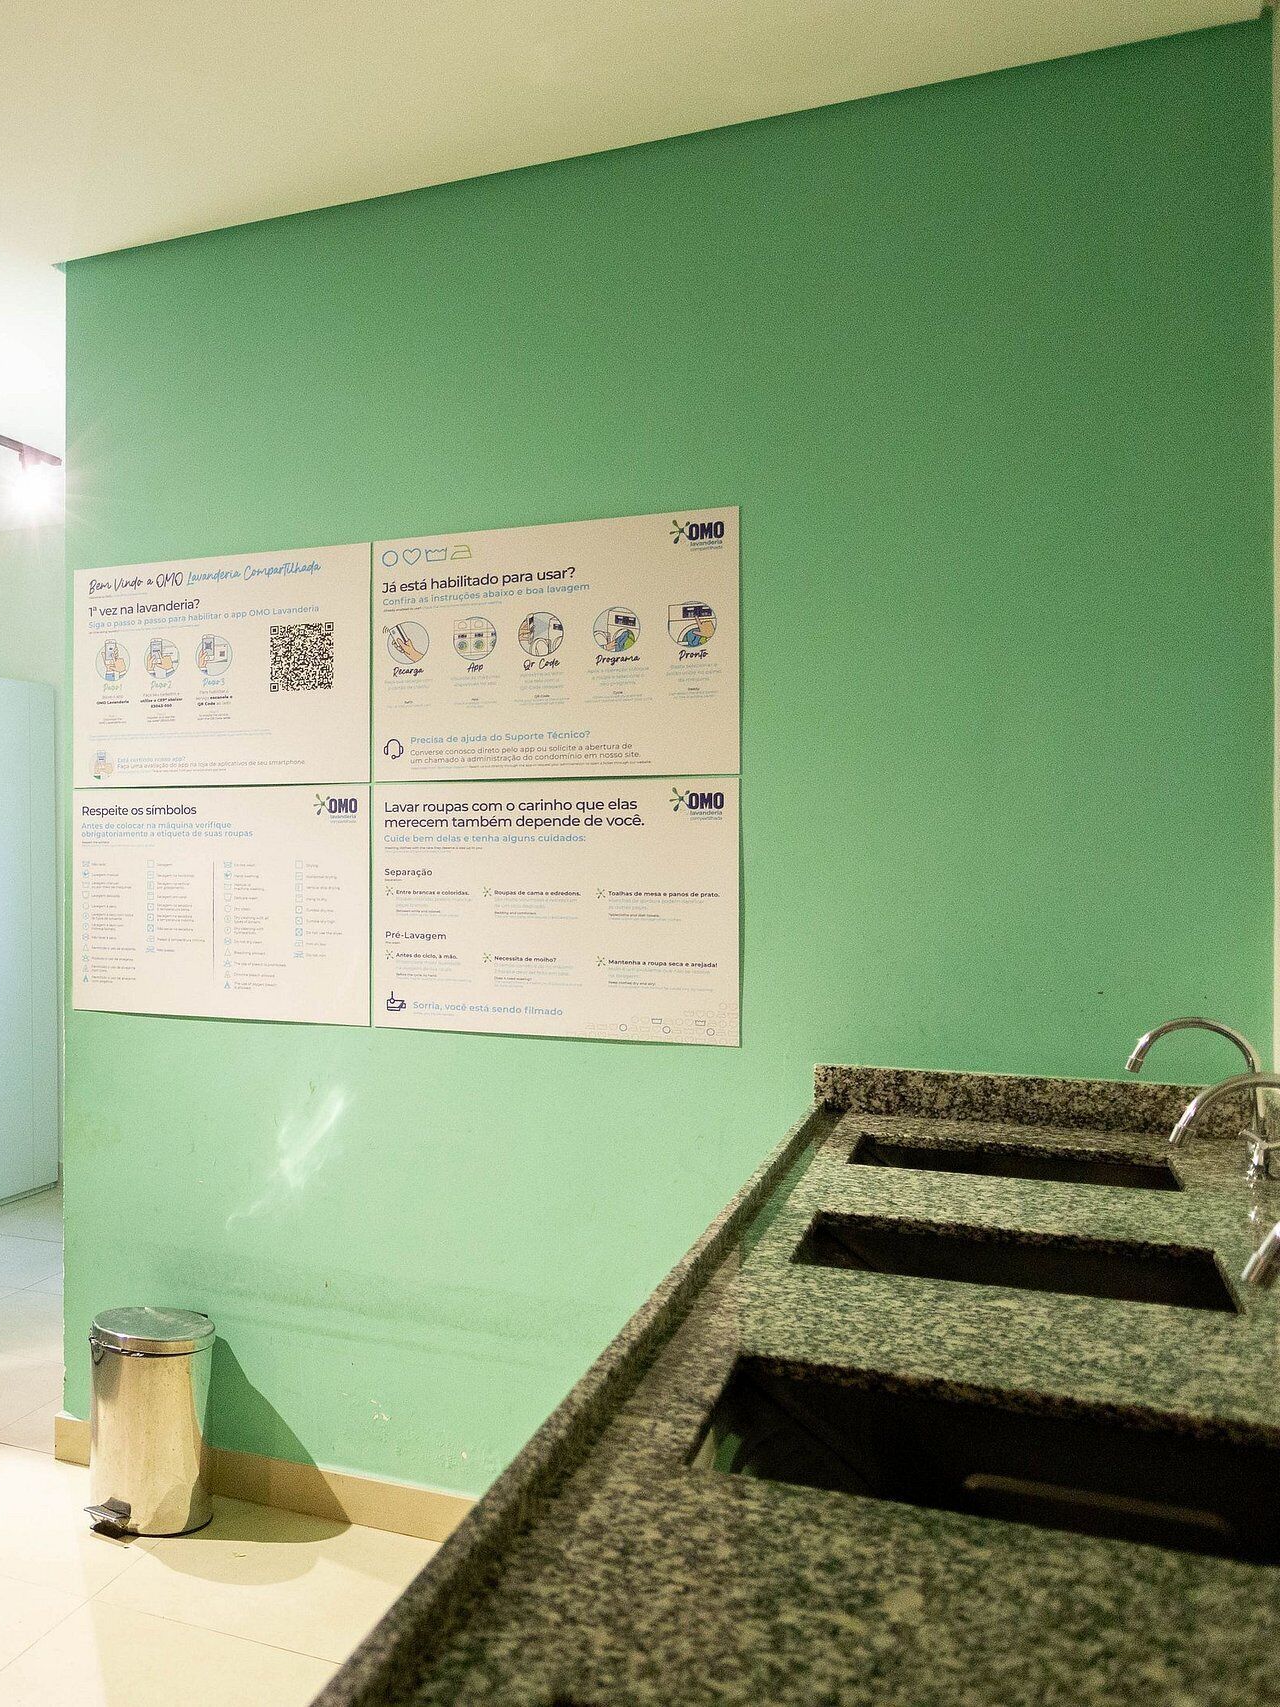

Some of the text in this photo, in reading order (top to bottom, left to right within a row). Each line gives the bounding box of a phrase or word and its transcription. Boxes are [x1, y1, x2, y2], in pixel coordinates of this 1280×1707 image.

[689, 520, 725, 540] OMO
[89, 579, 111, 595] Bem
[114, 577, 143, 591] Vindo
[156, 572, 183, 588] OMO
[187, 569, 241, 586] Lavanderia
[244, 560, 321, 580] Compartilhada
[382, 566, 576, 594] Já está habilitado para usar?
[383, 597, 416, 606] Confira
[431, 591, 480, 602] instruções
[483, 589, 514, 599] abaixo
[526, 585, 544, 595] boa
[547, 583, 590, 594] lavagem
[100, 608, 117, 616] vez
[120, 606, 134, 615] na
[137, 598, 200, 613] lavanderia?
[89, 621, 105, 630] Siga
[113, 619, 135, 628] passo
[144, 617, 166, 626] passo
[168, 616, 186, 625] para
[188, 612, 221, 621] habilitar
[231, 611, 247, 620] app
[249, 608, 271, 617] OMO
[273, 605, 320, 616] Lavanderia
[595, 654, 641, 666] Programa
[679, 648, 709, 661] Pronto
[467, 662, 484, 673] App
[538, 657, 560, 670] Code
[393, 666, 424, 678] Recarga
[410, 730, 590, 744] Precisa de ajuda do Suporte Técnico?
[328, 798, 358, 814] OMO
[384, 802, 420, 813] Lavar
[422, 803, 469, 814] roupas
[471, 802, 503, 812] com
[518, 799, 572, 811] carinho
[576, 801, 605, 813] que
[608, 798, 638, 810] elas
[688, 792, 724, 810] OMO
[82, 804, 197, 818] Respeite os símbolos
[105, 822, 115, 830] de
[116, 822, 145, 830] colocar
[158, 821, 193, 831] máquina
[195, 821, 232, 831] verifique
[384, 814, 645, 829] merecem também depende de você.
[81, 830, 148, 839] obrigatoriamente
[157, 830, 190, 839] etiqueta
[224, 831, 253, 839] roupas
[384, 834, 410, 842] Cuide
[412, 834, 434, 842] bem
[436, 834, 461, 842] delas
[472, 834, 500, 842] tenha
[502, 833, 536, 844] alguns
[537, 834, 586, 843] cuidados:
[384, 868, 433, 878] Separação
[385, 931, 447, 941] Pré-Lavagem
[413, 1001, 563, 1016] Sorria, você está sendo filmado
